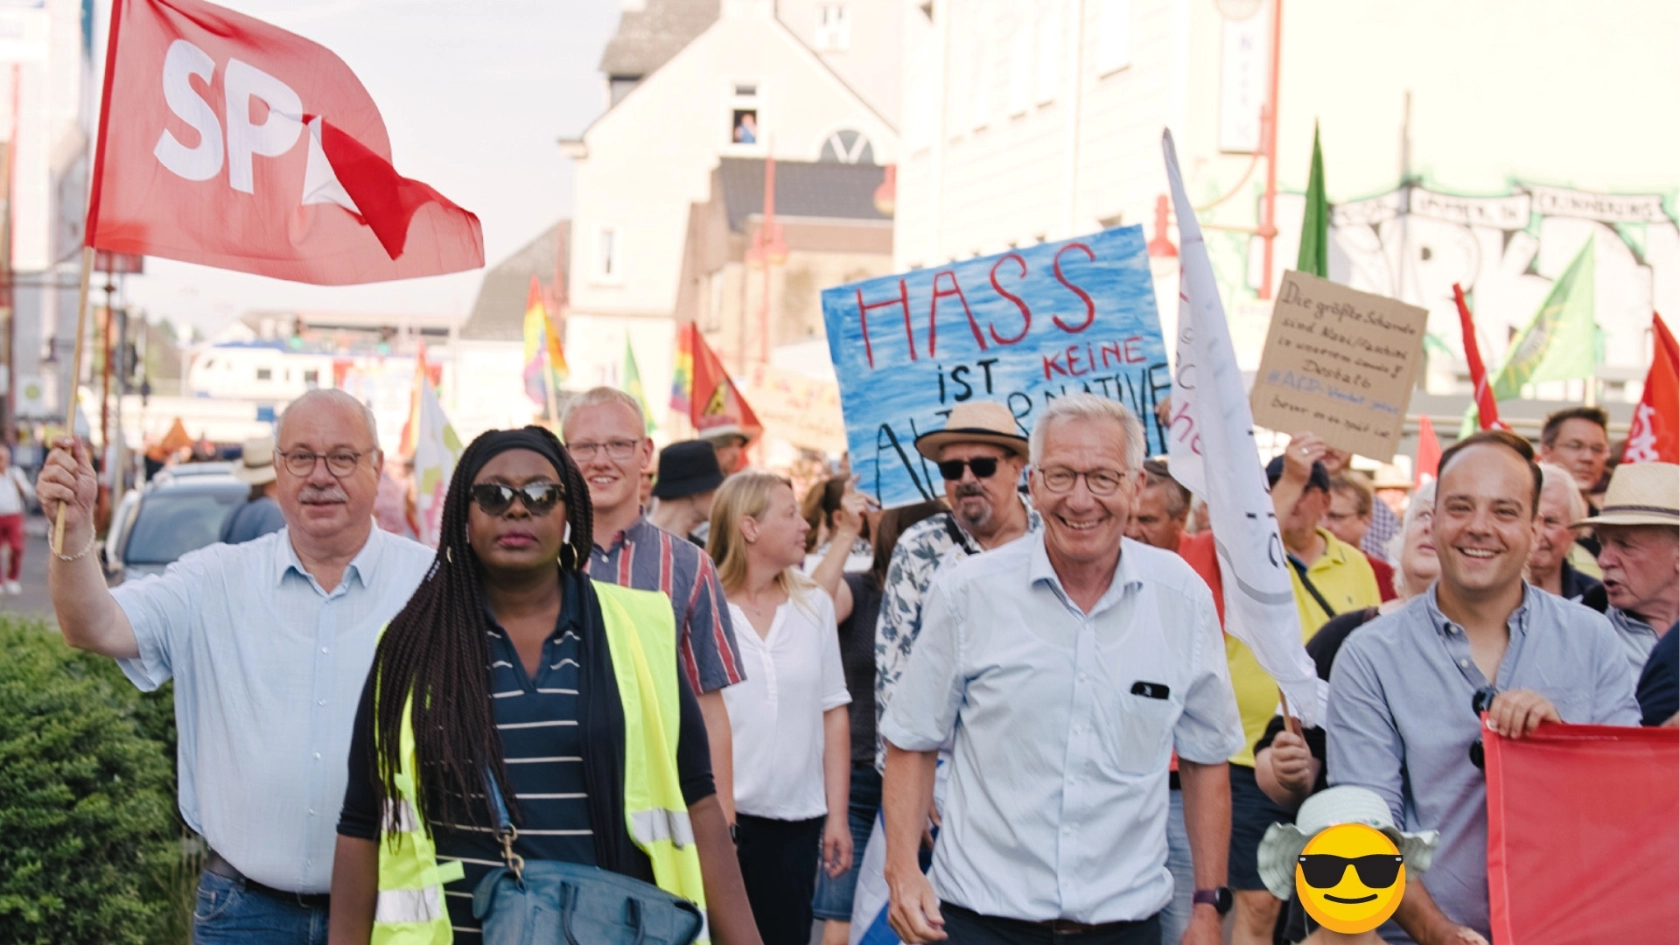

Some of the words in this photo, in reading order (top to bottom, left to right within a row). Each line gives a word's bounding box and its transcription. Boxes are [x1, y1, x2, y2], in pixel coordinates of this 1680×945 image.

[855, 241, 1097, 370] HASS
[1282, 280, 1312, 309] Die
[1315, 302, 1363, 324] größte
[1281, 317, 1316, 335] sind
